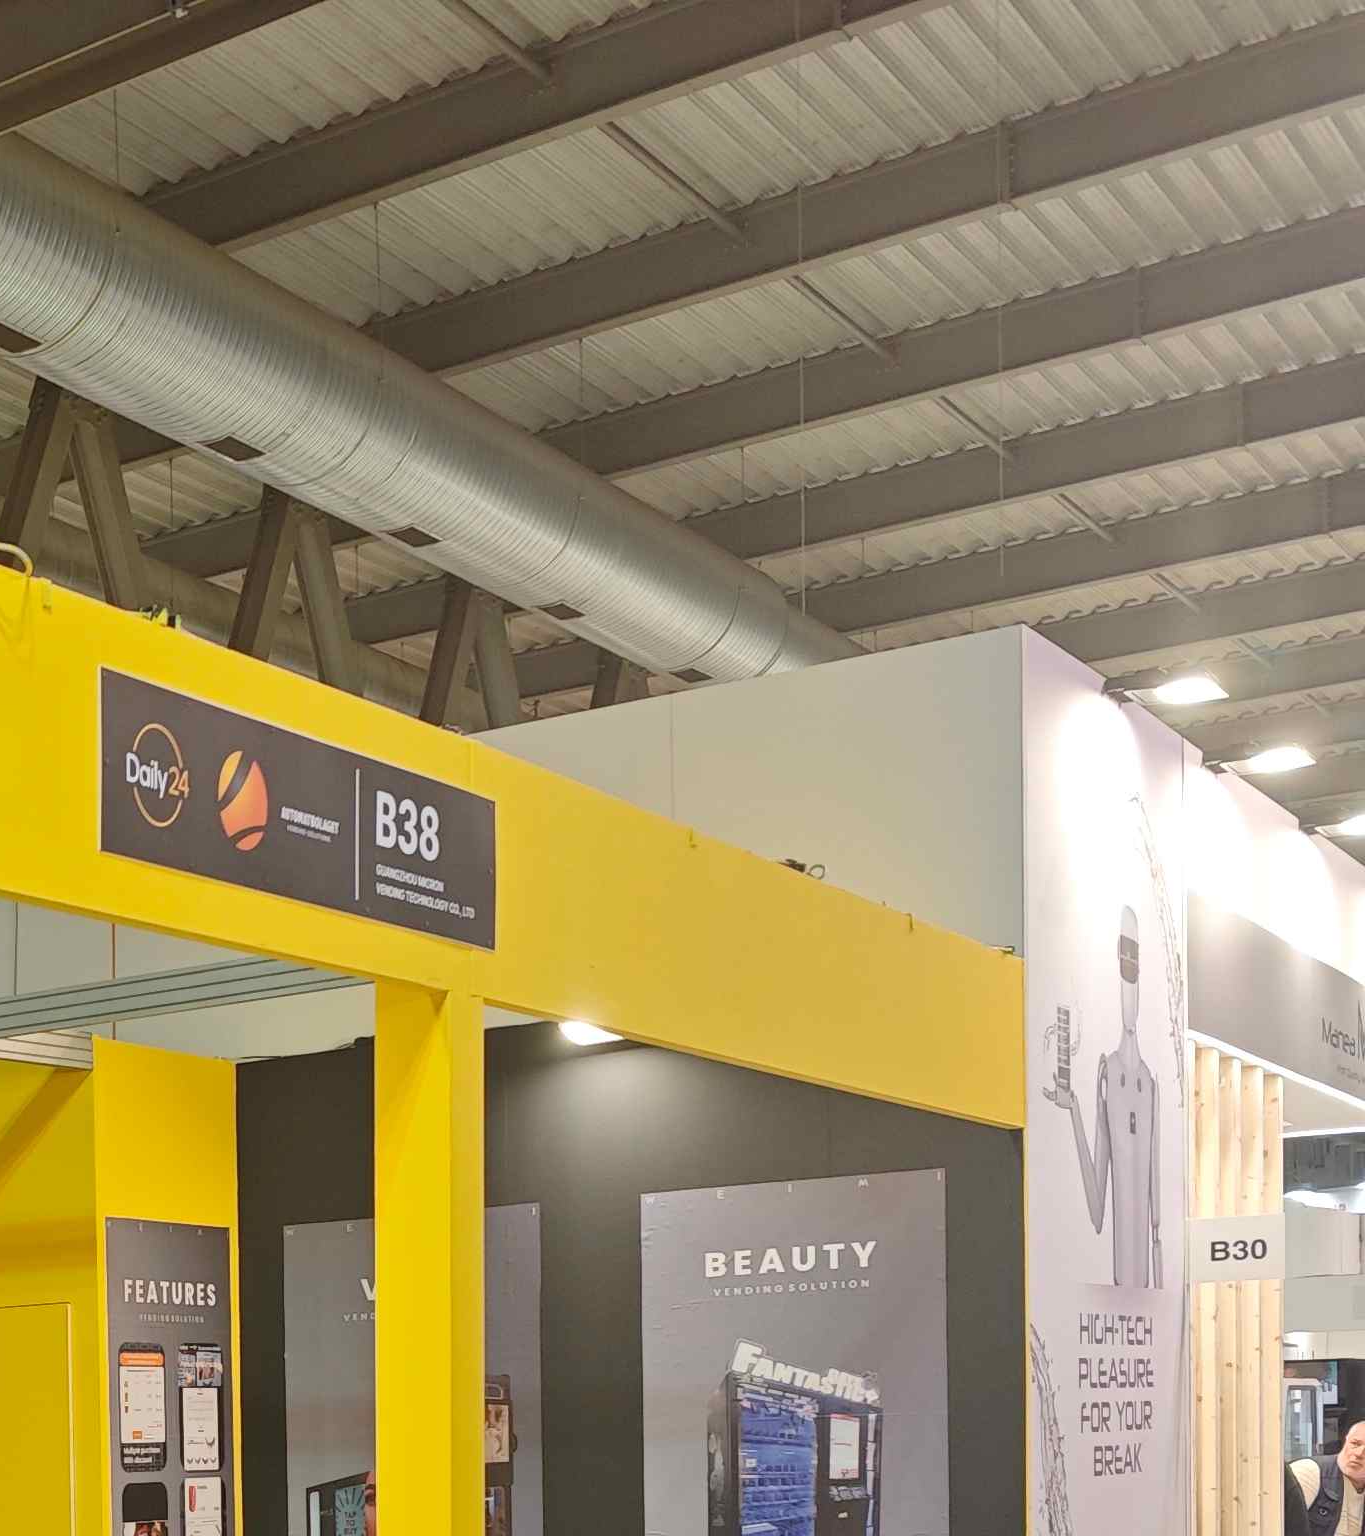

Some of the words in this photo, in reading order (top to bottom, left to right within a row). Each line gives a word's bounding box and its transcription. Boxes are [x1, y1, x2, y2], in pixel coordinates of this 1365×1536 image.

[375, 790, 440, 862] B38
[704, 1240, 877, 1279] BEAUTY
[1210, 1239, 1268, 1262] B30
[123, 1279, 217, 1307] FEATURES
[712, 1283, 785, 1297] VENDING
[787, 1278, 871, 1293] SOLUTION
[1079, 1312, 1154, 1346] HIGH-TECH
[1078, 1357, 1155, 1389] PLEASURE
[1080, 1401, 1111, 1434] FOR
[1115, 1400, 1153, 1431] YOUR
[1093, 1443, 1143, 1477] BREAK
